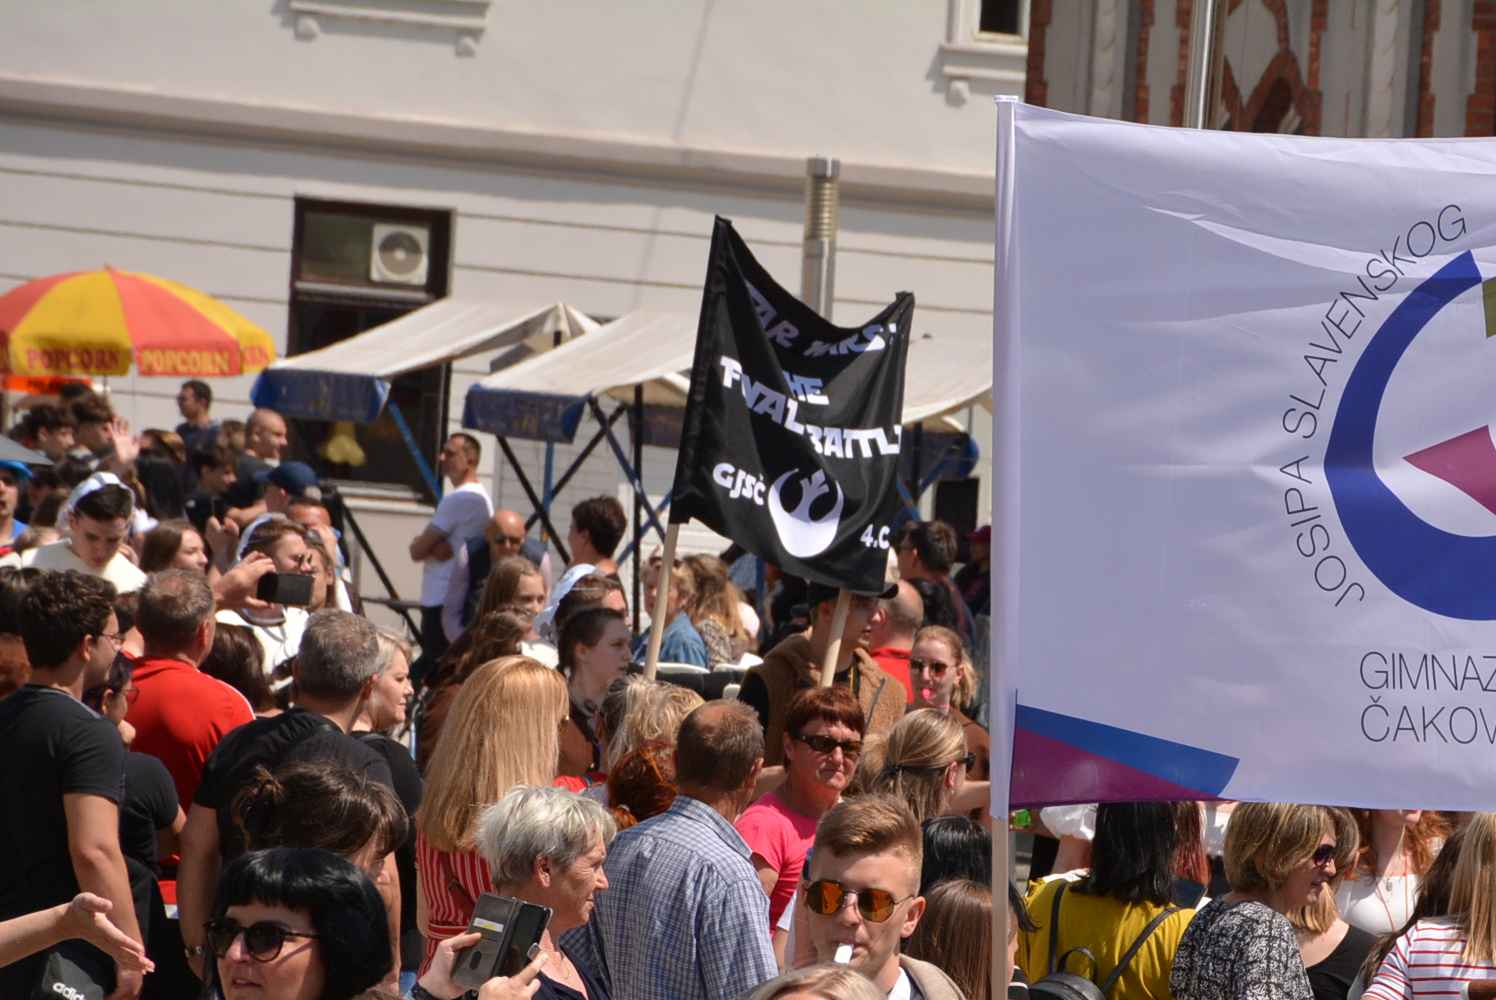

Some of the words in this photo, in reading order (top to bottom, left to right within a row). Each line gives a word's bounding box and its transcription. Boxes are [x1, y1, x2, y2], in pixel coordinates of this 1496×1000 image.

[143, 349, 228, 373] POPCORN
[1282, 204, 1467, 439] SLAVENSKOG
[782, 369, 830, 406] HE
[1280, 456, 1365, 607] JOSIPA
